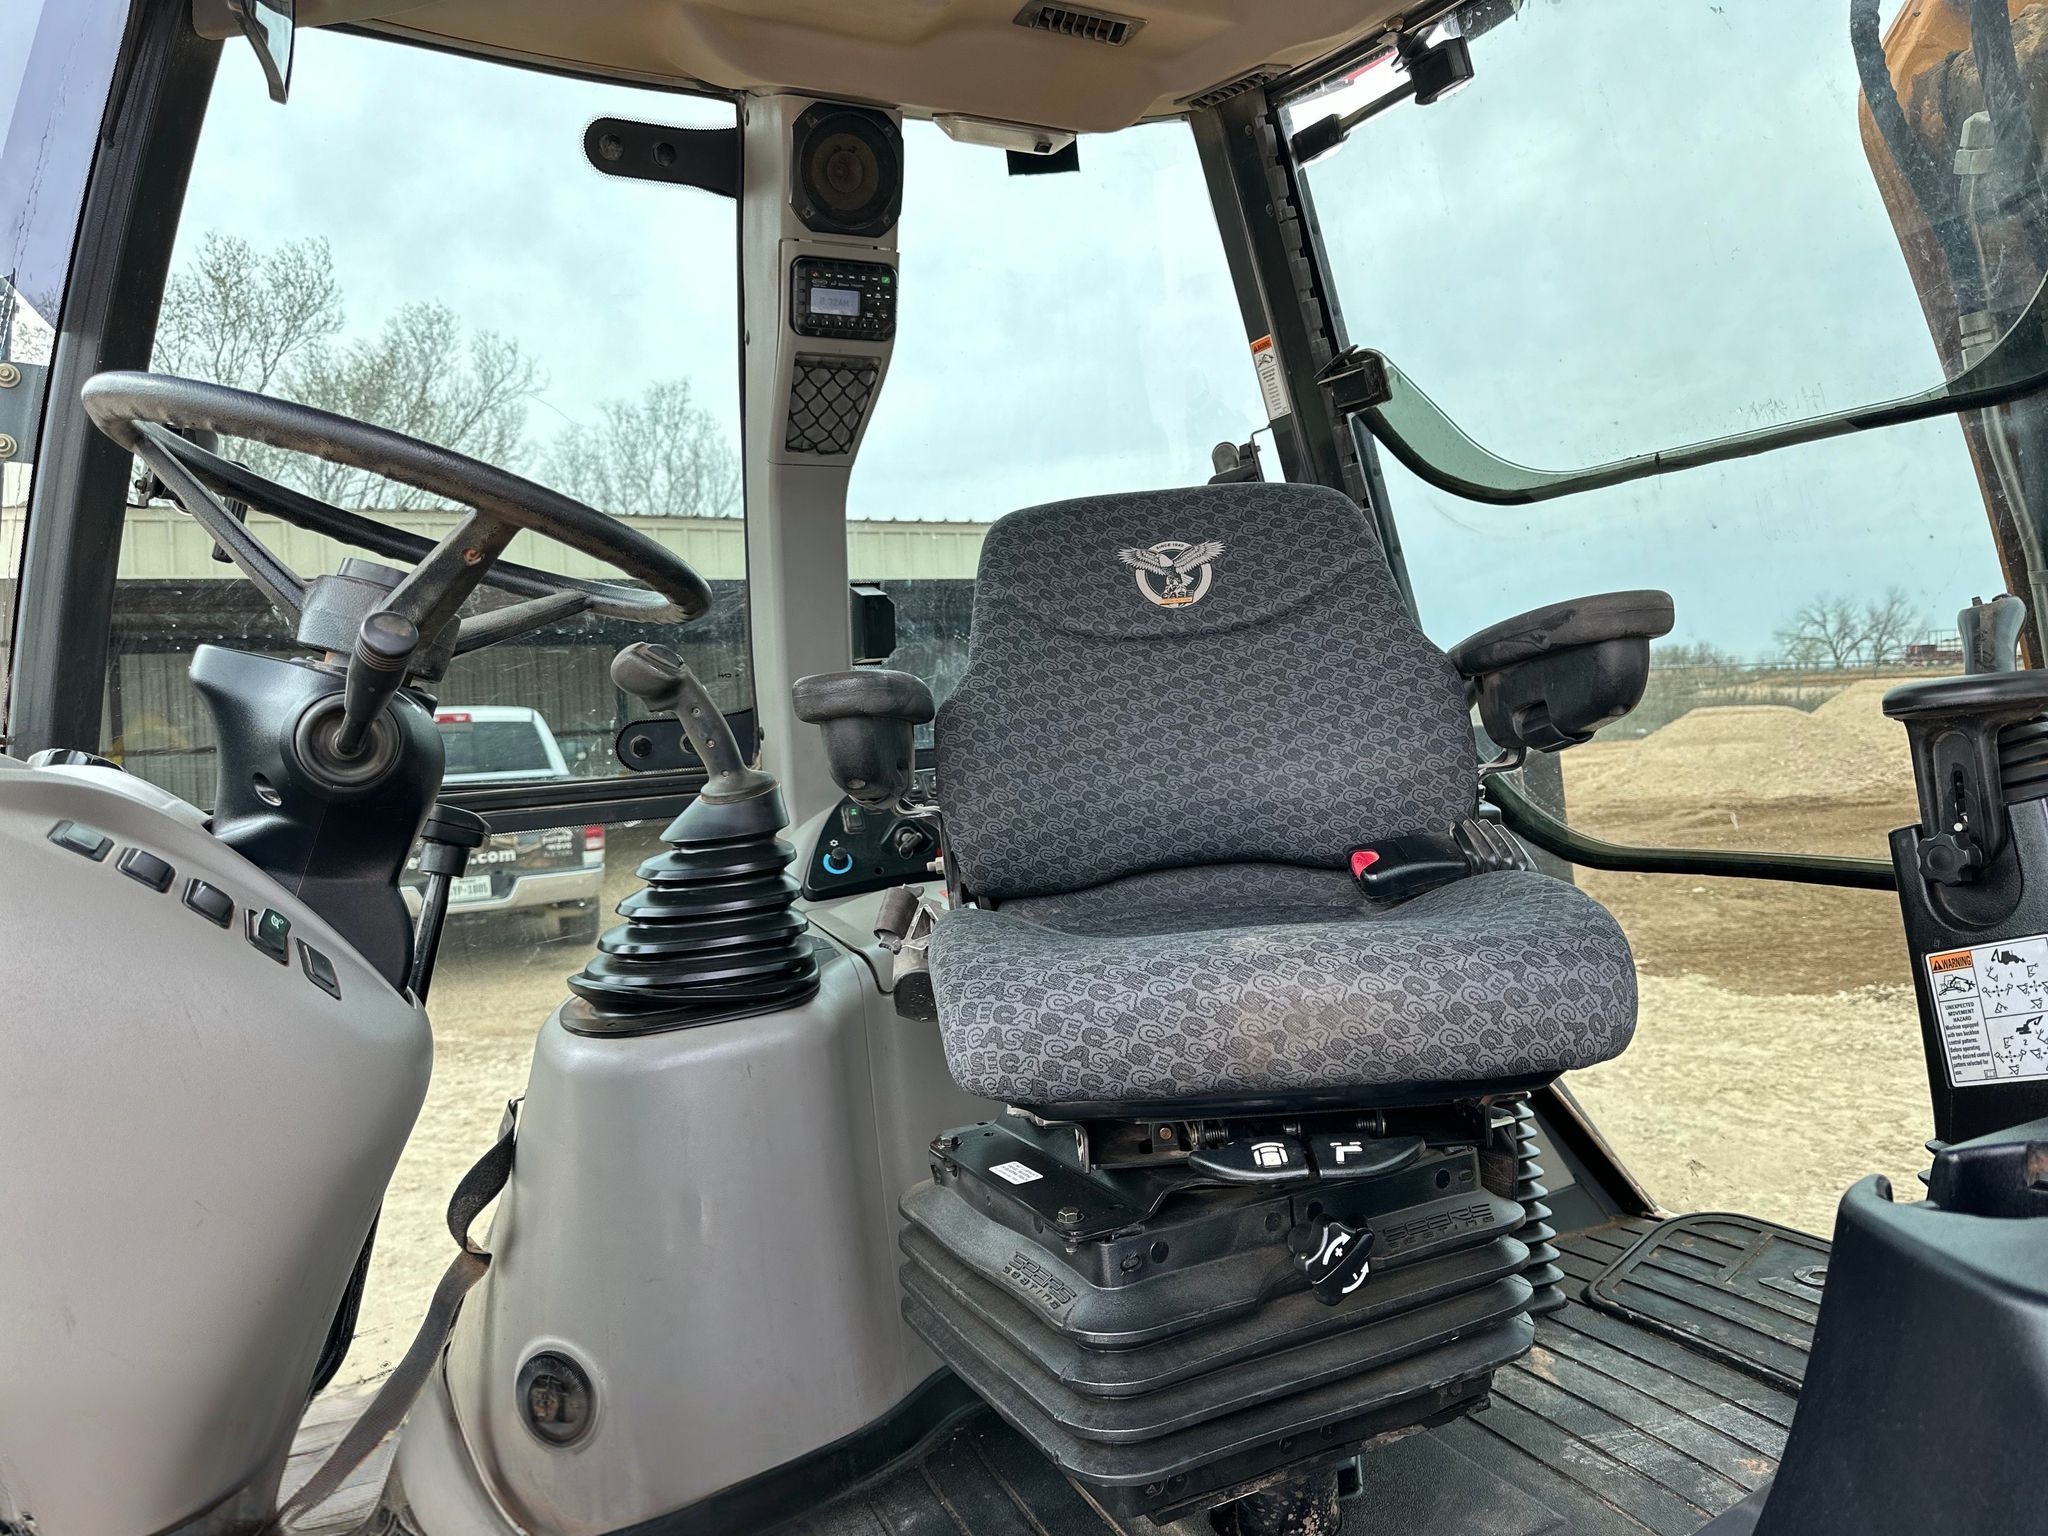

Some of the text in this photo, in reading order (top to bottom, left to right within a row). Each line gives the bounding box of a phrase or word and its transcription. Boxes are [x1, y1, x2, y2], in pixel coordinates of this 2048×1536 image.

[1156, 542, 1171, 550] SINCE
[1161, 590, 1194, 599] CASE
[1941, 956, 1972, 970] WARNING
[1945, 1002, 1974, 1010] UNEXPECTED
[1382, 1203, 1493, 1242] SEARS
[1008, 1251, 1077, 1304] SEARS
